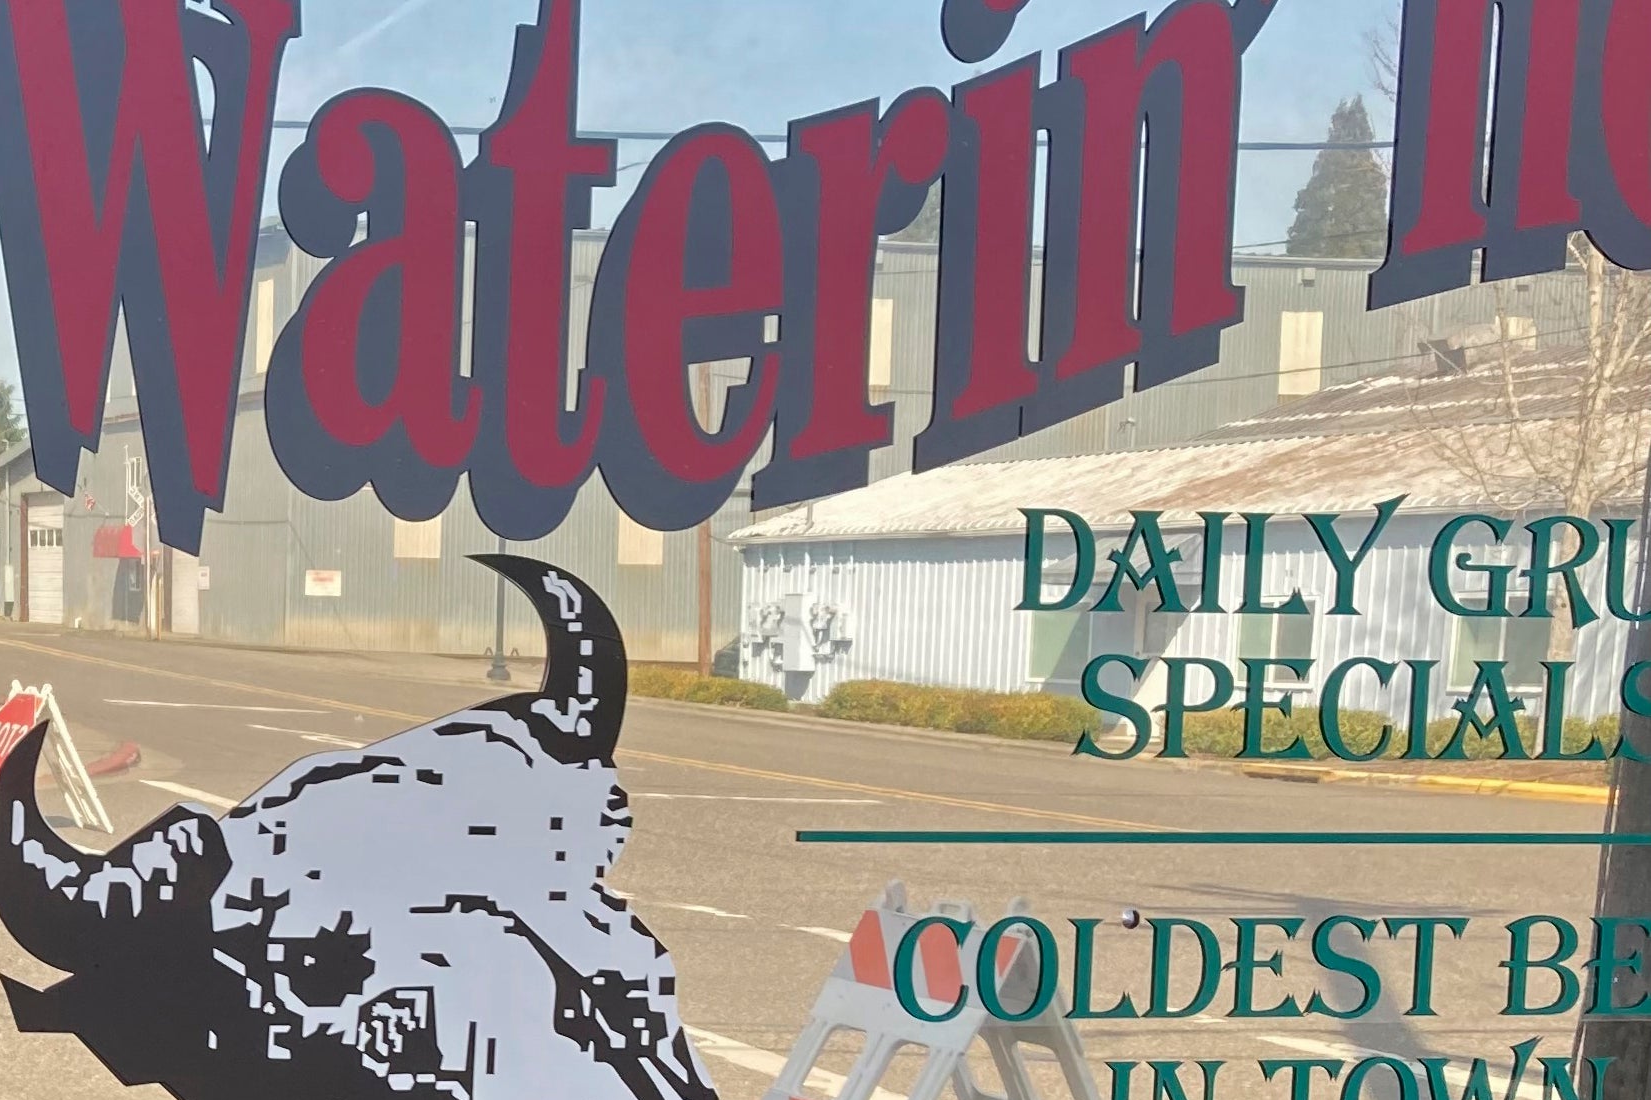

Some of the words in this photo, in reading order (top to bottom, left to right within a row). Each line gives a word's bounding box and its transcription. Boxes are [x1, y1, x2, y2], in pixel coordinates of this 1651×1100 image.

[1014, 493, 1411, 618] DAILY
[892, 914, 1470, 1023] COLDEST
[1496, 914, 1651, 1018] BE
